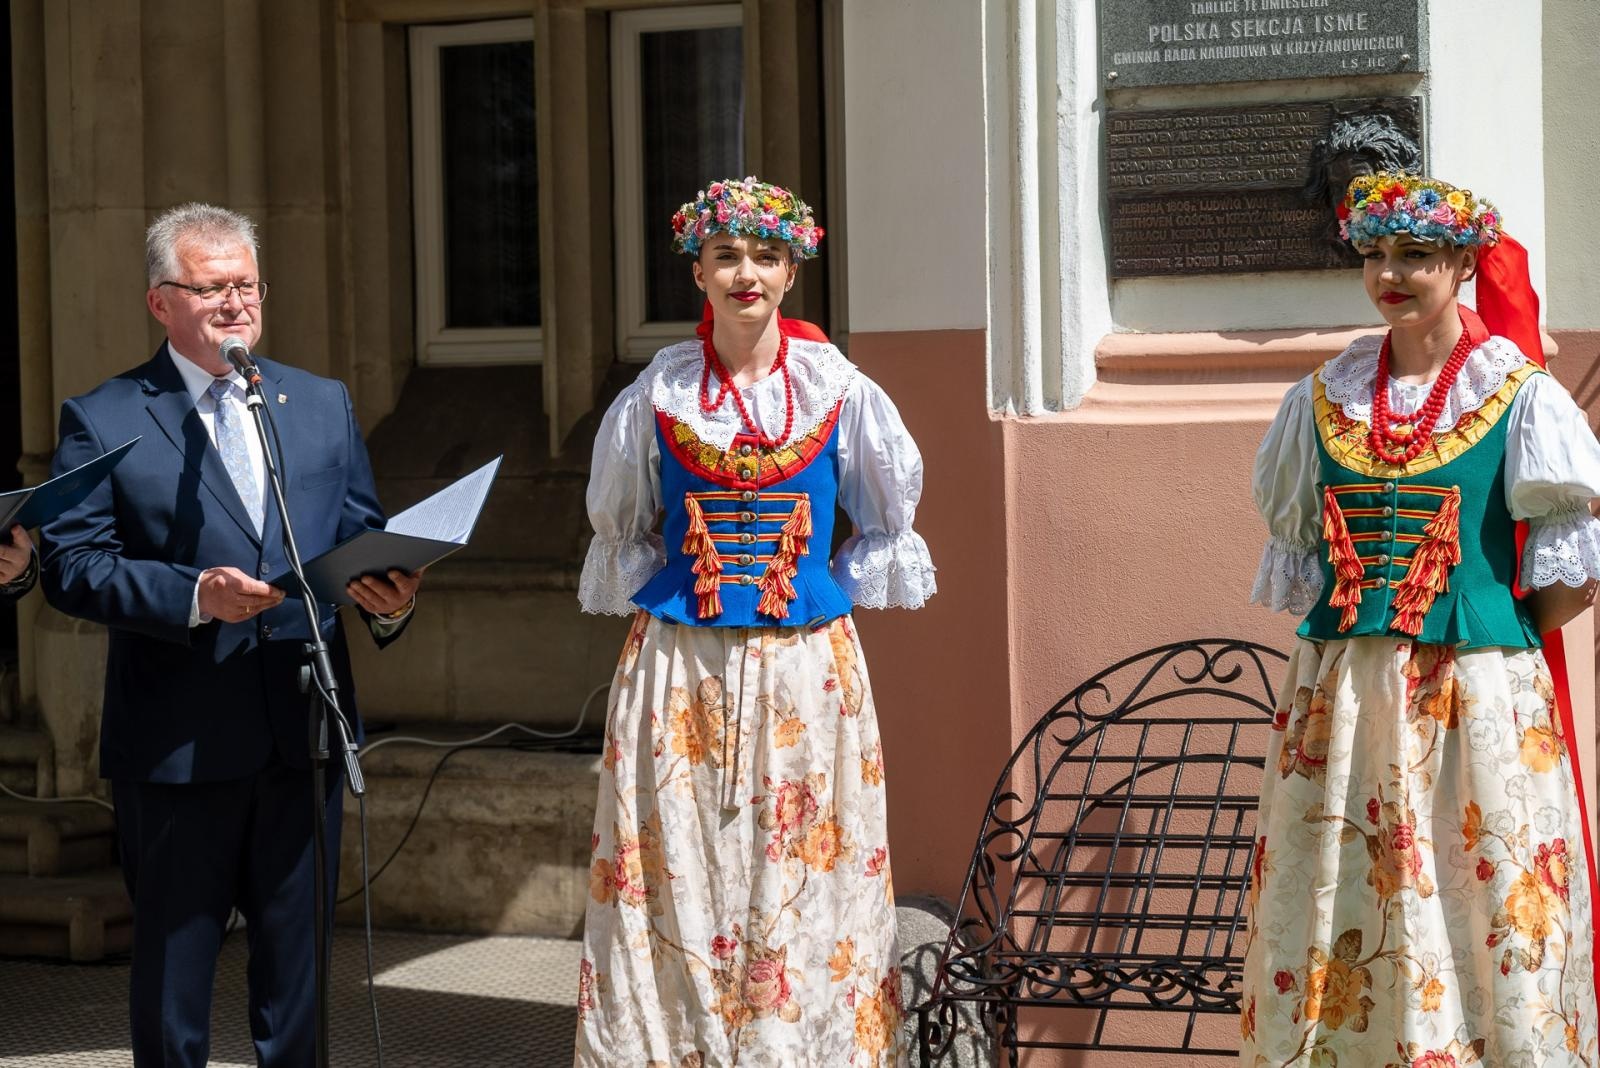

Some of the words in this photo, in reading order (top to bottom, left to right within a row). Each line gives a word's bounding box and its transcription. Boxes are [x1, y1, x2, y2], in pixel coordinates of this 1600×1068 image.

[1190, 1, 1240, 15] TABLICE
[1149, 20, 1220, 43] POLSKA
[1230, 16, 1304, 38] SEKCJA
[1314, 12, 1369, 33] ISME
[1113, 50, 1161, 65] GMINNA
[1164, 48, 1197, 62] RADA
[1200, 44, 1267, 60] NARODOWA
[1271, 42, 1282, 56] W
[1286, 35, 1405, 55] KRZYŻANOWICACH
[1200, 198, 1242, 212] LUDWIG
[1112, 216, 1173, 229] BEETHOVEN
